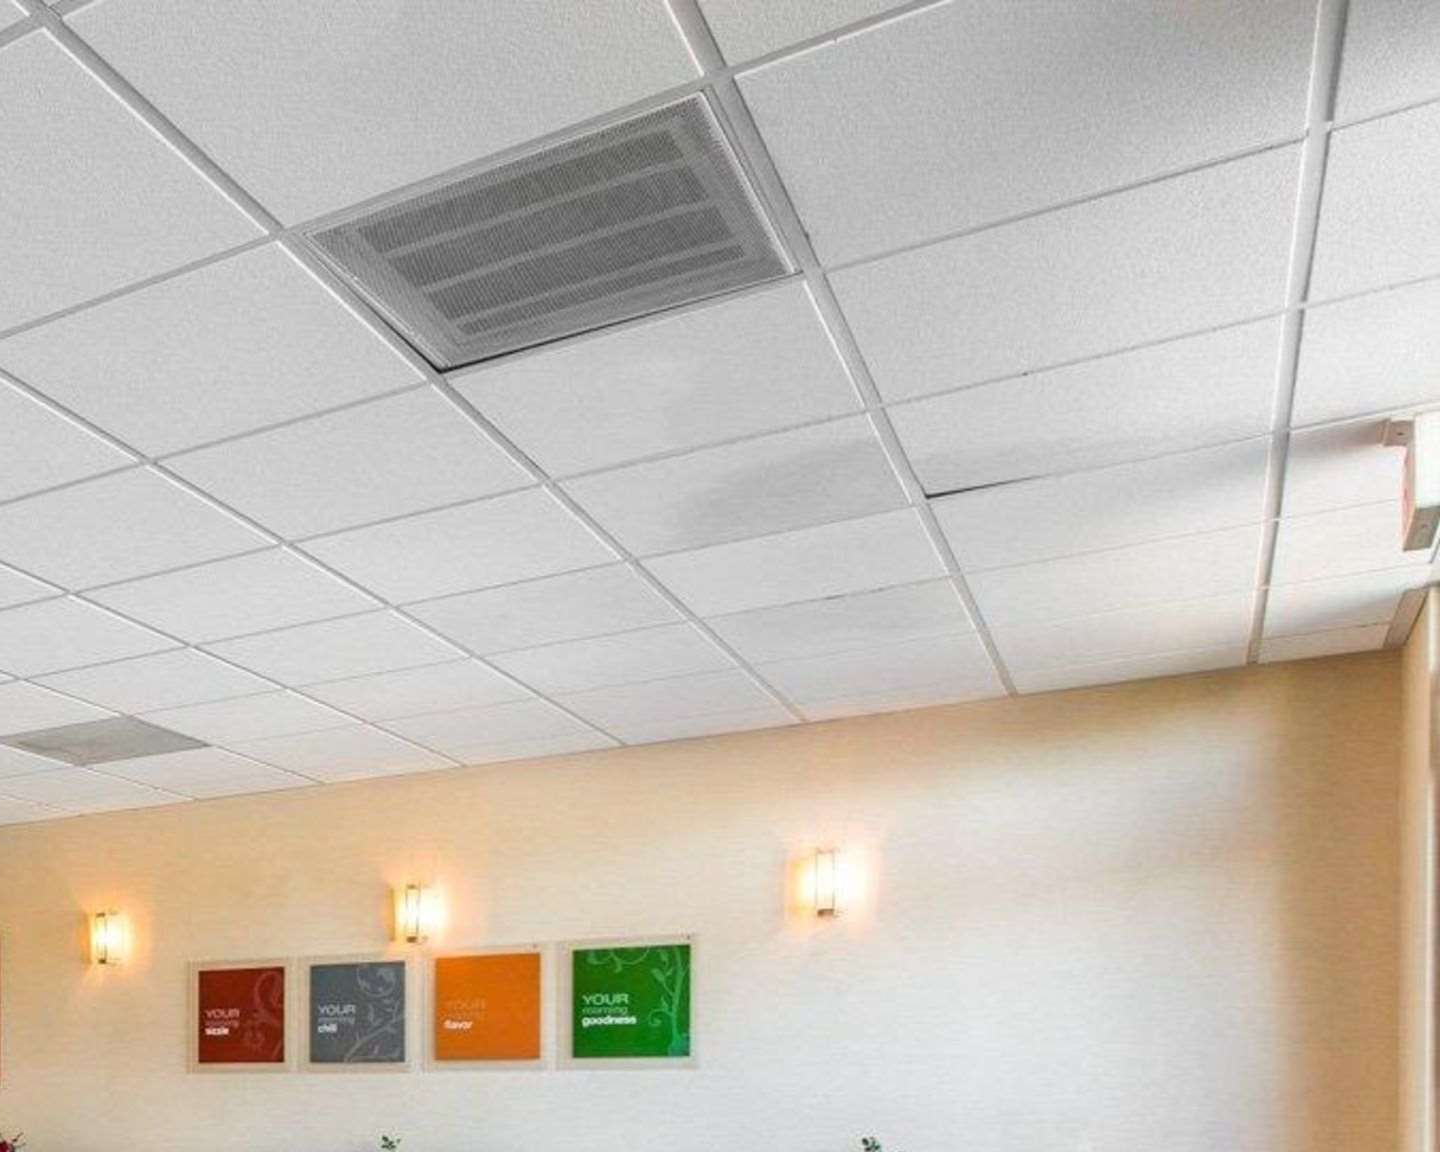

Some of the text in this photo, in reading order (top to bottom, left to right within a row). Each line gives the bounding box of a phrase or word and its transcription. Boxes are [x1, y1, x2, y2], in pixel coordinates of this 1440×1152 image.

[582, 993, 629, 1006] YOUR
[205, 1008, 240, 1018] YOUR
[317, 1004, 356, 1014] YOUR
[581, 1015, 637, 1028] goodness
